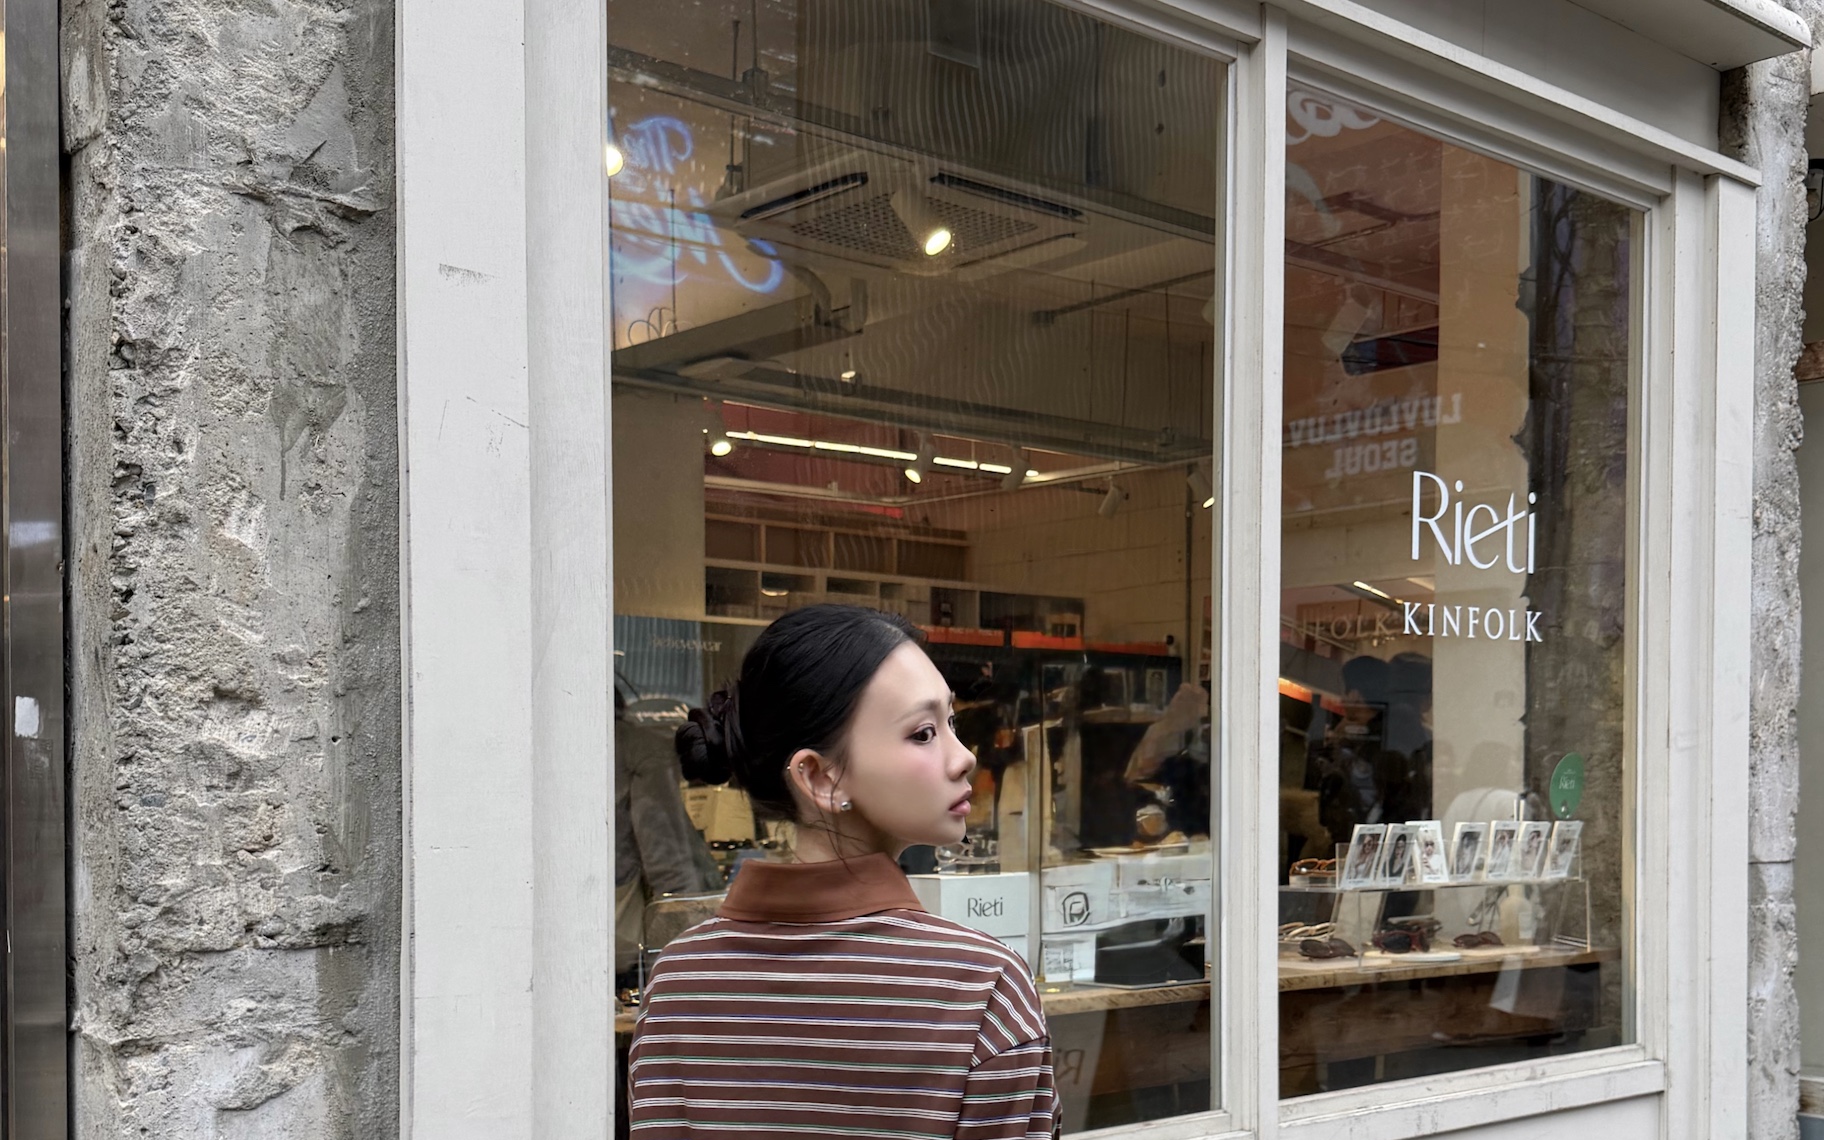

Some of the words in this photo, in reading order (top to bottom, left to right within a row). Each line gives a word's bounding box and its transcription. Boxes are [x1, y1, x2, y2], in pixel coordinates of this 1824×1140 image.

[1411, 470, 1537, 575] Rieti
[1402, 601, 1544, 642] KINFOLK
[967, 896, 1003, 918] Rieti
